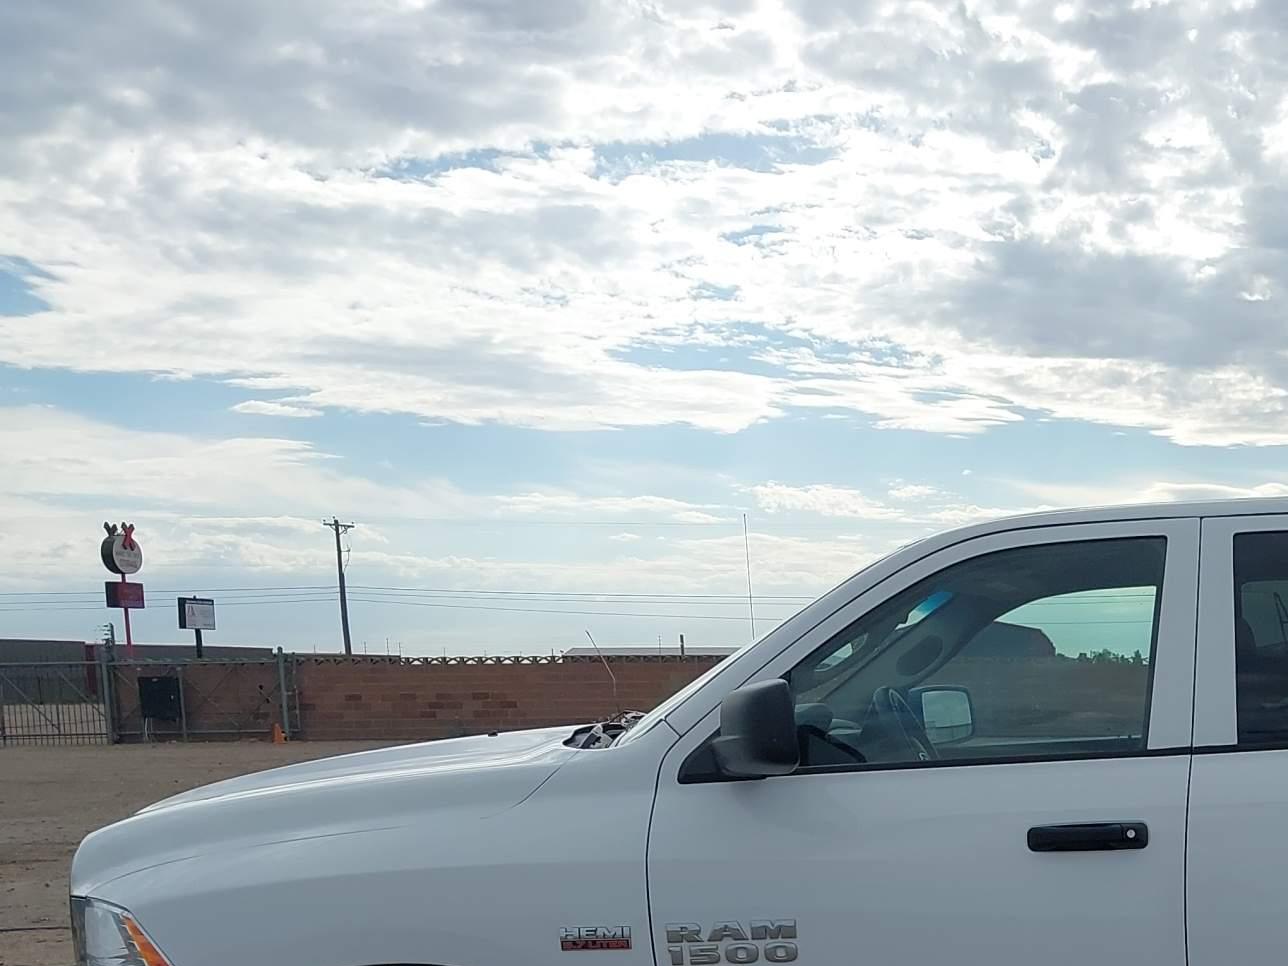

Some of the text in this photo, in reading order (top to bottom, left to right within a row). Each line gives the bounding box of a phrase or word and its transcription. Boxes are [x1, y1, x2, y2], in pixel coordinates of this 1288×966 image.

[560, 926, 631, 939] HEMI
[665, 920, 798, 943] RAM
[667, 942, 799, 966] 1500
